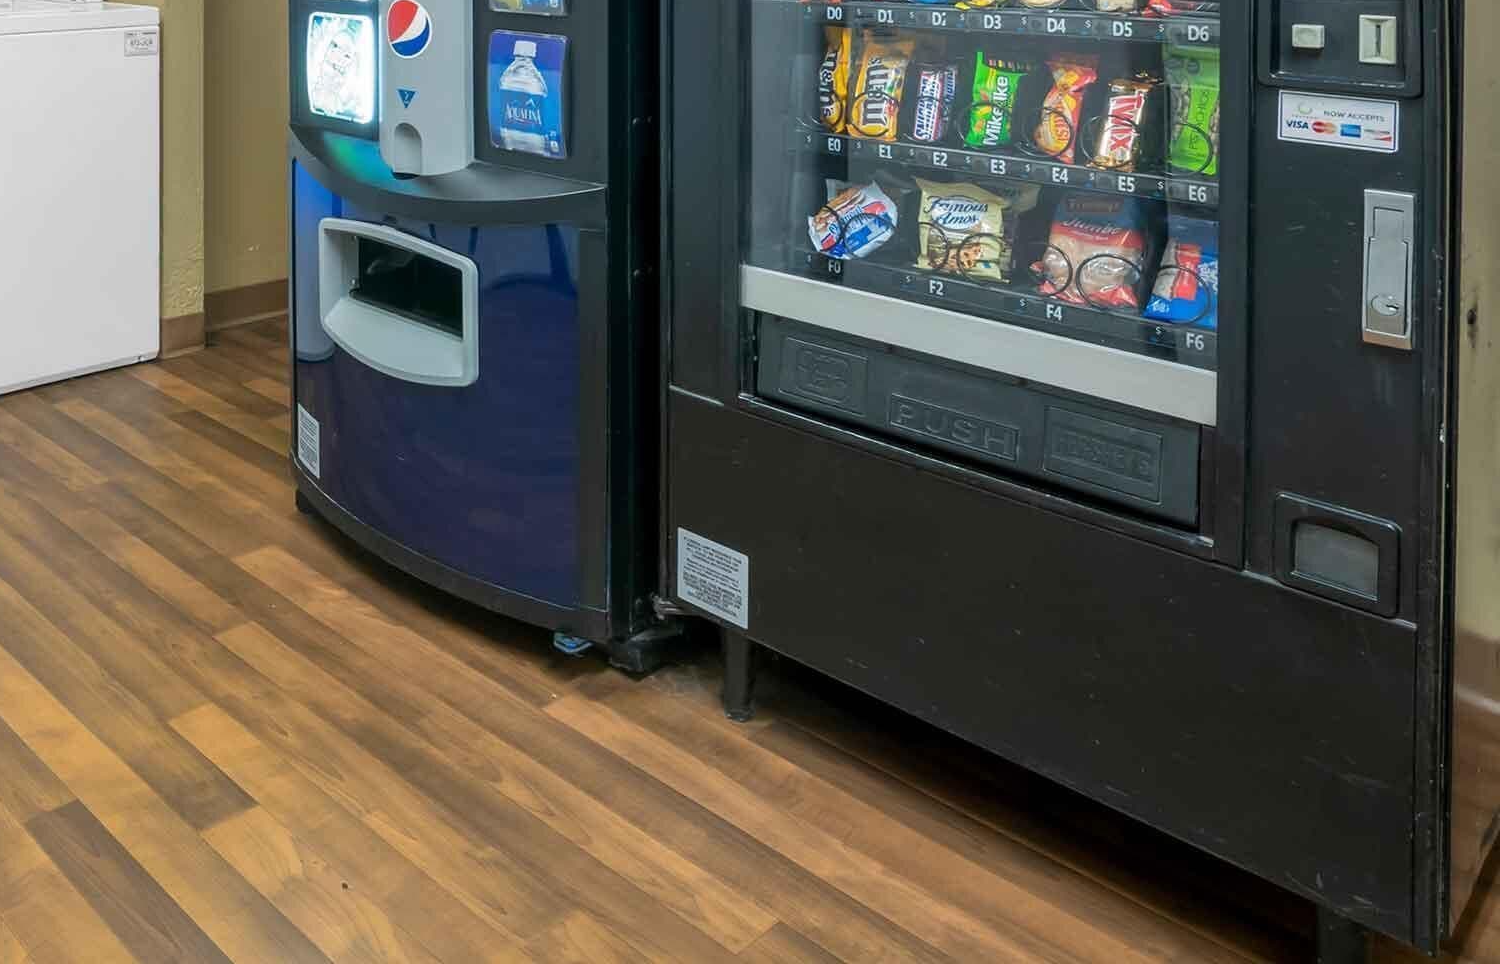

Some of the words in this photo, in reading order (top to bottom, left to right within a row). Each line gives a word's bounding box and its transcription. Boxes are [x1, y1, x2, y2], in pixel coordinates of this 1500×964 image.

[826, 7, 842, 21] D0
[878, 9, 894, 24] D1
[984, 15, 1002, 29] D3
[1047, 18, 1066, 34] D4
[1112, 22, 1133, 37] D5
[1187, 25, 1209, 42] D6
[1323, 110, 1347, 118] NOW
[1286, 120, 1309, 130] VISA
[828, 138, 841, 152] E0
[879, 145, 893, 159] E1
[933, 152, 948, 167] E2
[991, 160, 1006, 175] E3
[1052, 167, 1068, 183] E4
[1118, 176, 1135, 192] E5
[1188, 185, 1207, 202] E6
[828, 260, 841, 274] F0
[929, 280, 944, 296] F2
[1046, 304, 1062, 321] F4
[1186, 332, 1205, 351] F6
[899, 404, 1018, 460] PUSH
